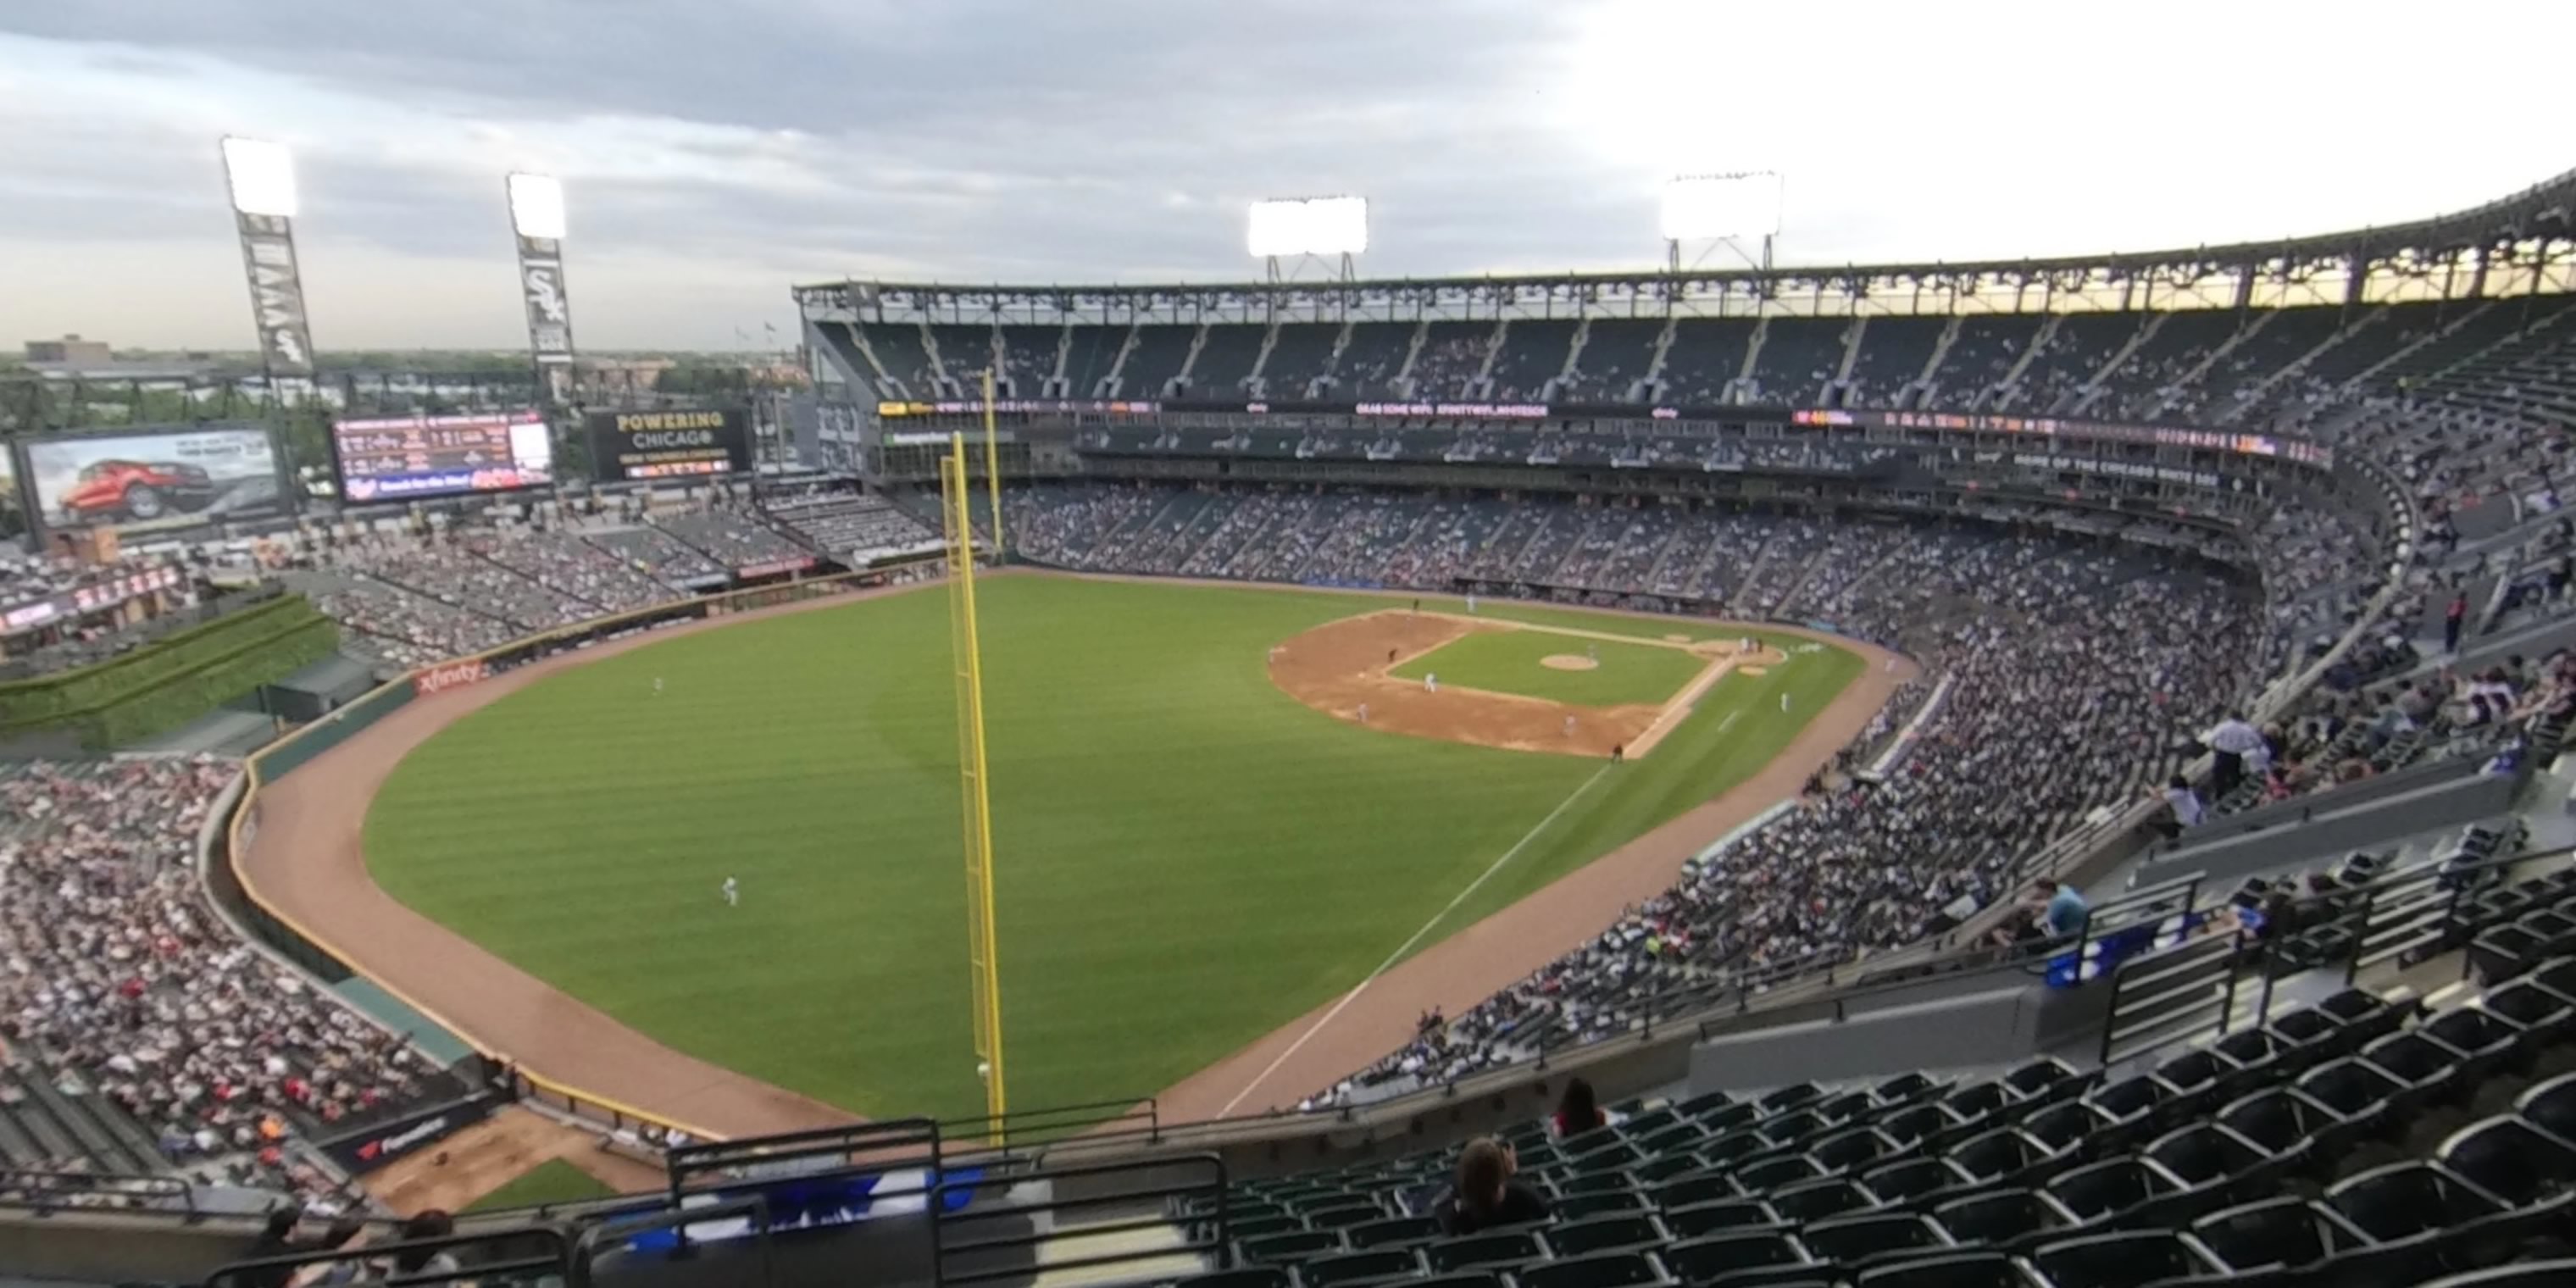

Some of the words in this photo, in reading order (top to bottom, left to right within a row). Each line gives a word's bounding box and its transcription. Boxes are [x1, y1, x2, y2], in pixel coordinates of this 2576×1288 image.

[616, 411, 725, 433] POWERING
[632, 430, 713, 450] CHICAGO
[2013, 453, 2050, 467] HOME
[2051, 456, 2071, 469] OF
[2074, 458, 2098, 473] THE
[2099, 460, 2156, 478] CHICAGO
[2157, 467, 2193, 483] WHITE
[419, 663, 480, 693] xfinity
